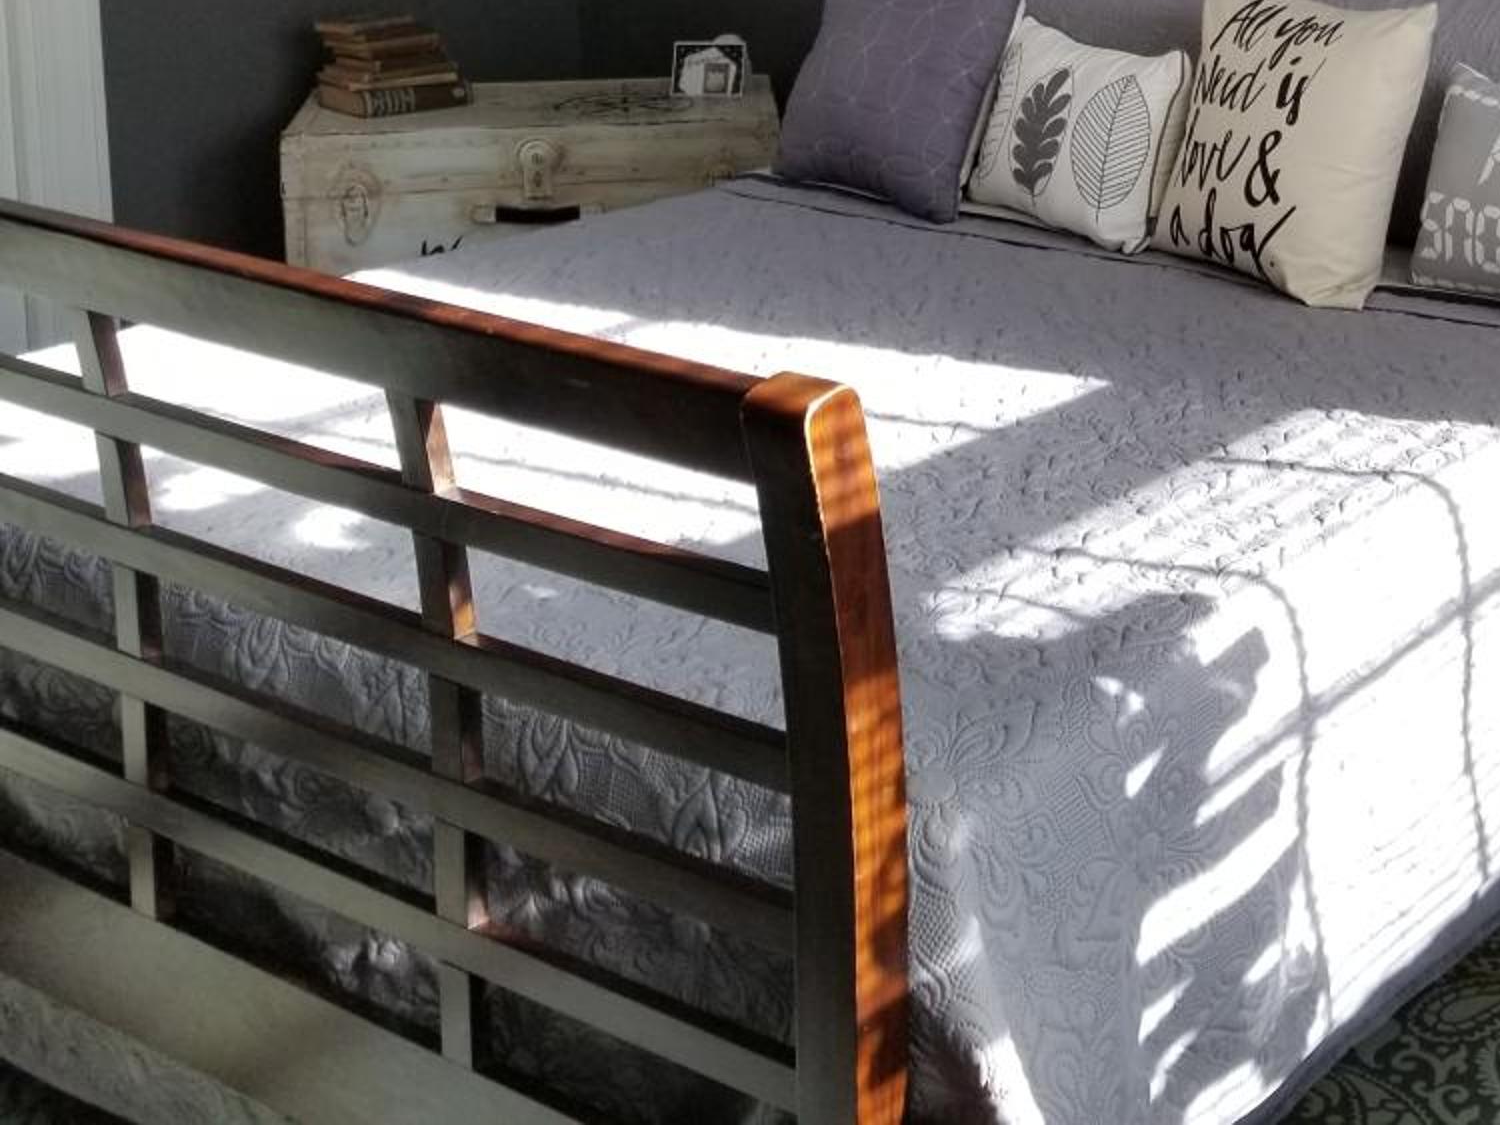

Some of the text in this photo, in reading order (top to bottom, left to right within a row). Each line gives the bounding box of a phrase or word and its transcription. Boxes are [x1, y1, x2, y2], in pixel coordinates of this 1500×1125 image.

[1268, 15, 1345, 71] you
[1243, 130, 1283, 208] &
[1169, 204, 1191, 247] a
